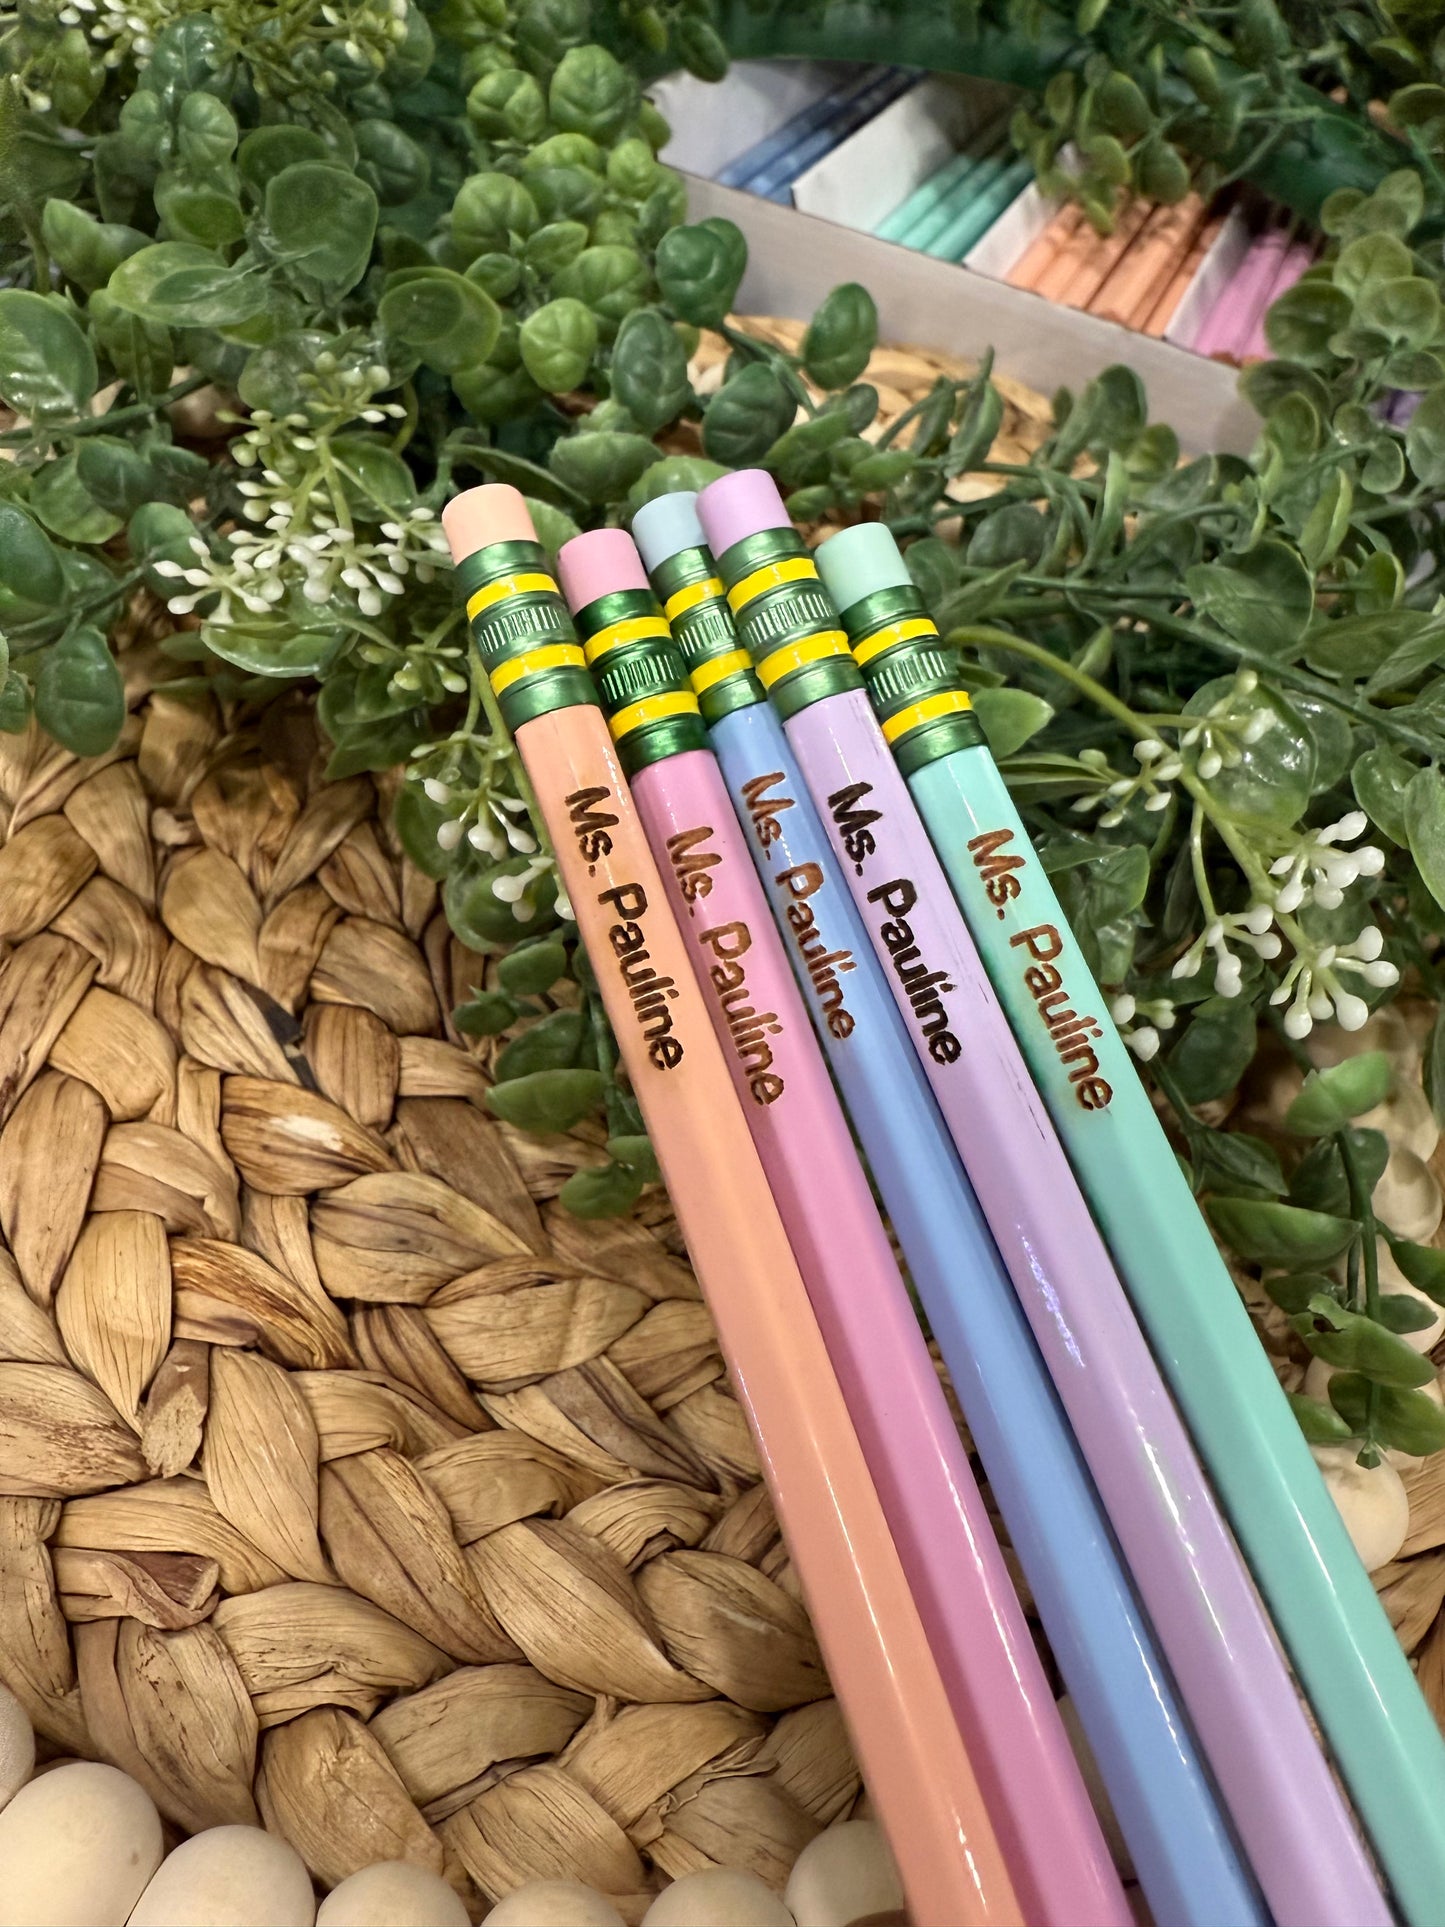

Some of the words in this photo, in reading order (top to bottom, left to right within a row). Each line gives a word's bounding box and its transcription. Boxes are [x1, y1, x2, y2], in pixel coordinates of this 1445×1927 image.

[565, 787, 620, 877] Ms.
[598, 882, 684, 1071] Pauline
[666, 826, 722, 918] Ms.
[699, 920, 784, 1105] Pauline
[741, 771, 796, 861] Ms.
[775, 861, 858, 1040] Pauline
[827, 781, 884, 877] Ms.
[866, 878, 963, 1066] Pauline
[966, 828, 1027, 920] Ms.
[1009, 923, 1114, 1112] Pauline
